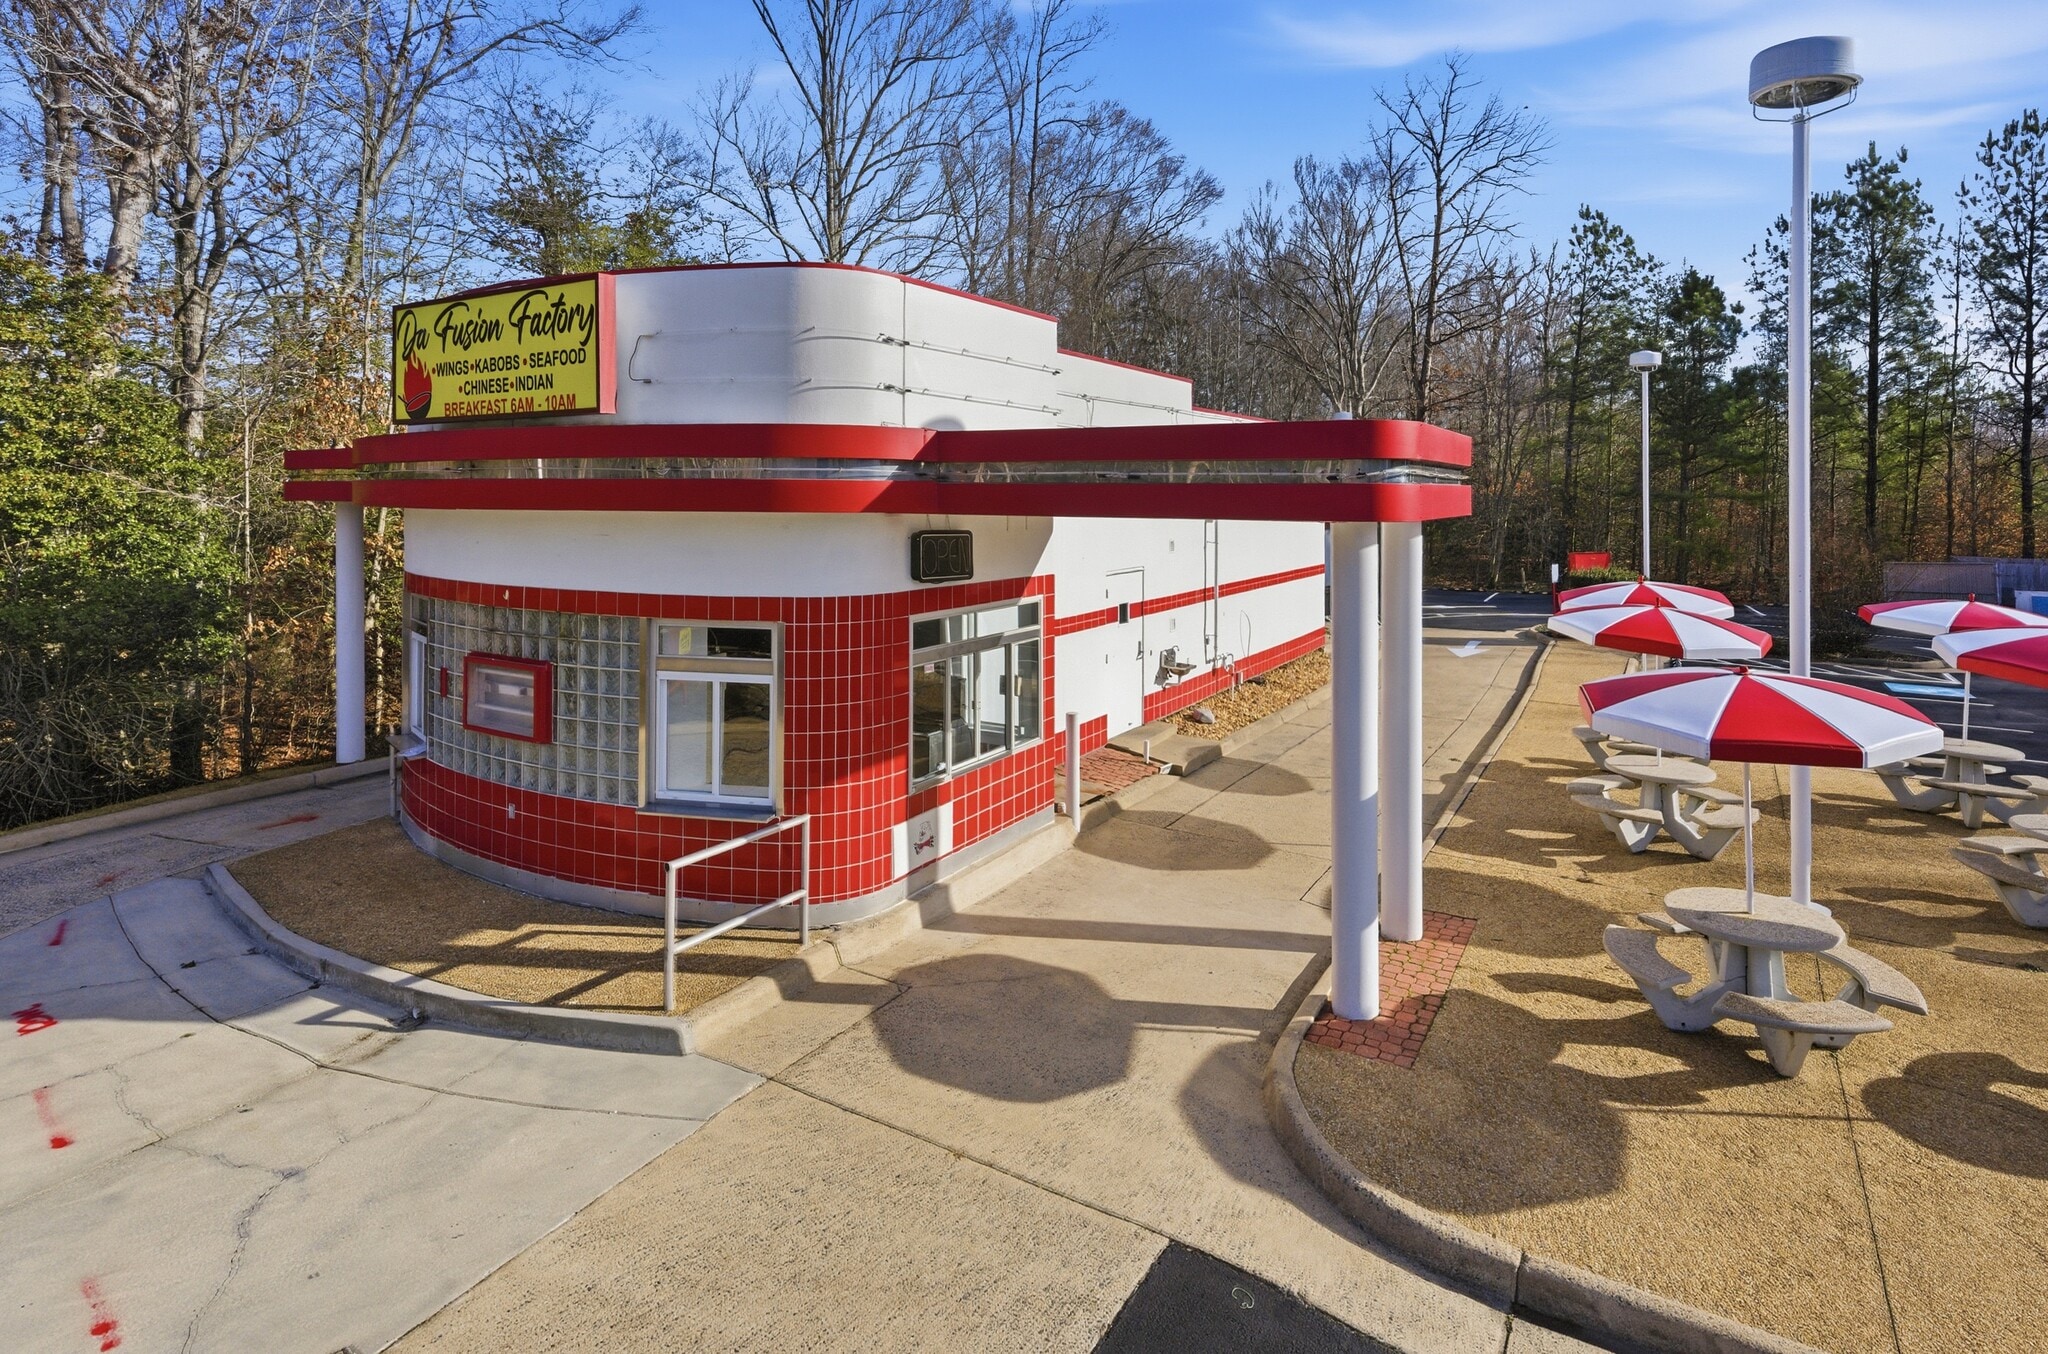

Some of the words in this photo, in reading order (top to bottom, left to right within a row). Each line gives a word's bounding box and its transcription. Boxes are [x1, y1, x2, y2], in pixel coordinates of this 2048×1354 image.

[397, 310, 429, 361] Da
[434, 302, 504, 353] Fusion
[508, 290, 595, 347] Factory
[444, 399, 506, 417] BREAKFAST
[511, 397, 534, 412] 6AM
[545, 394, 576, 410] 10AM
[924, 538, 969, 574] OPEN
